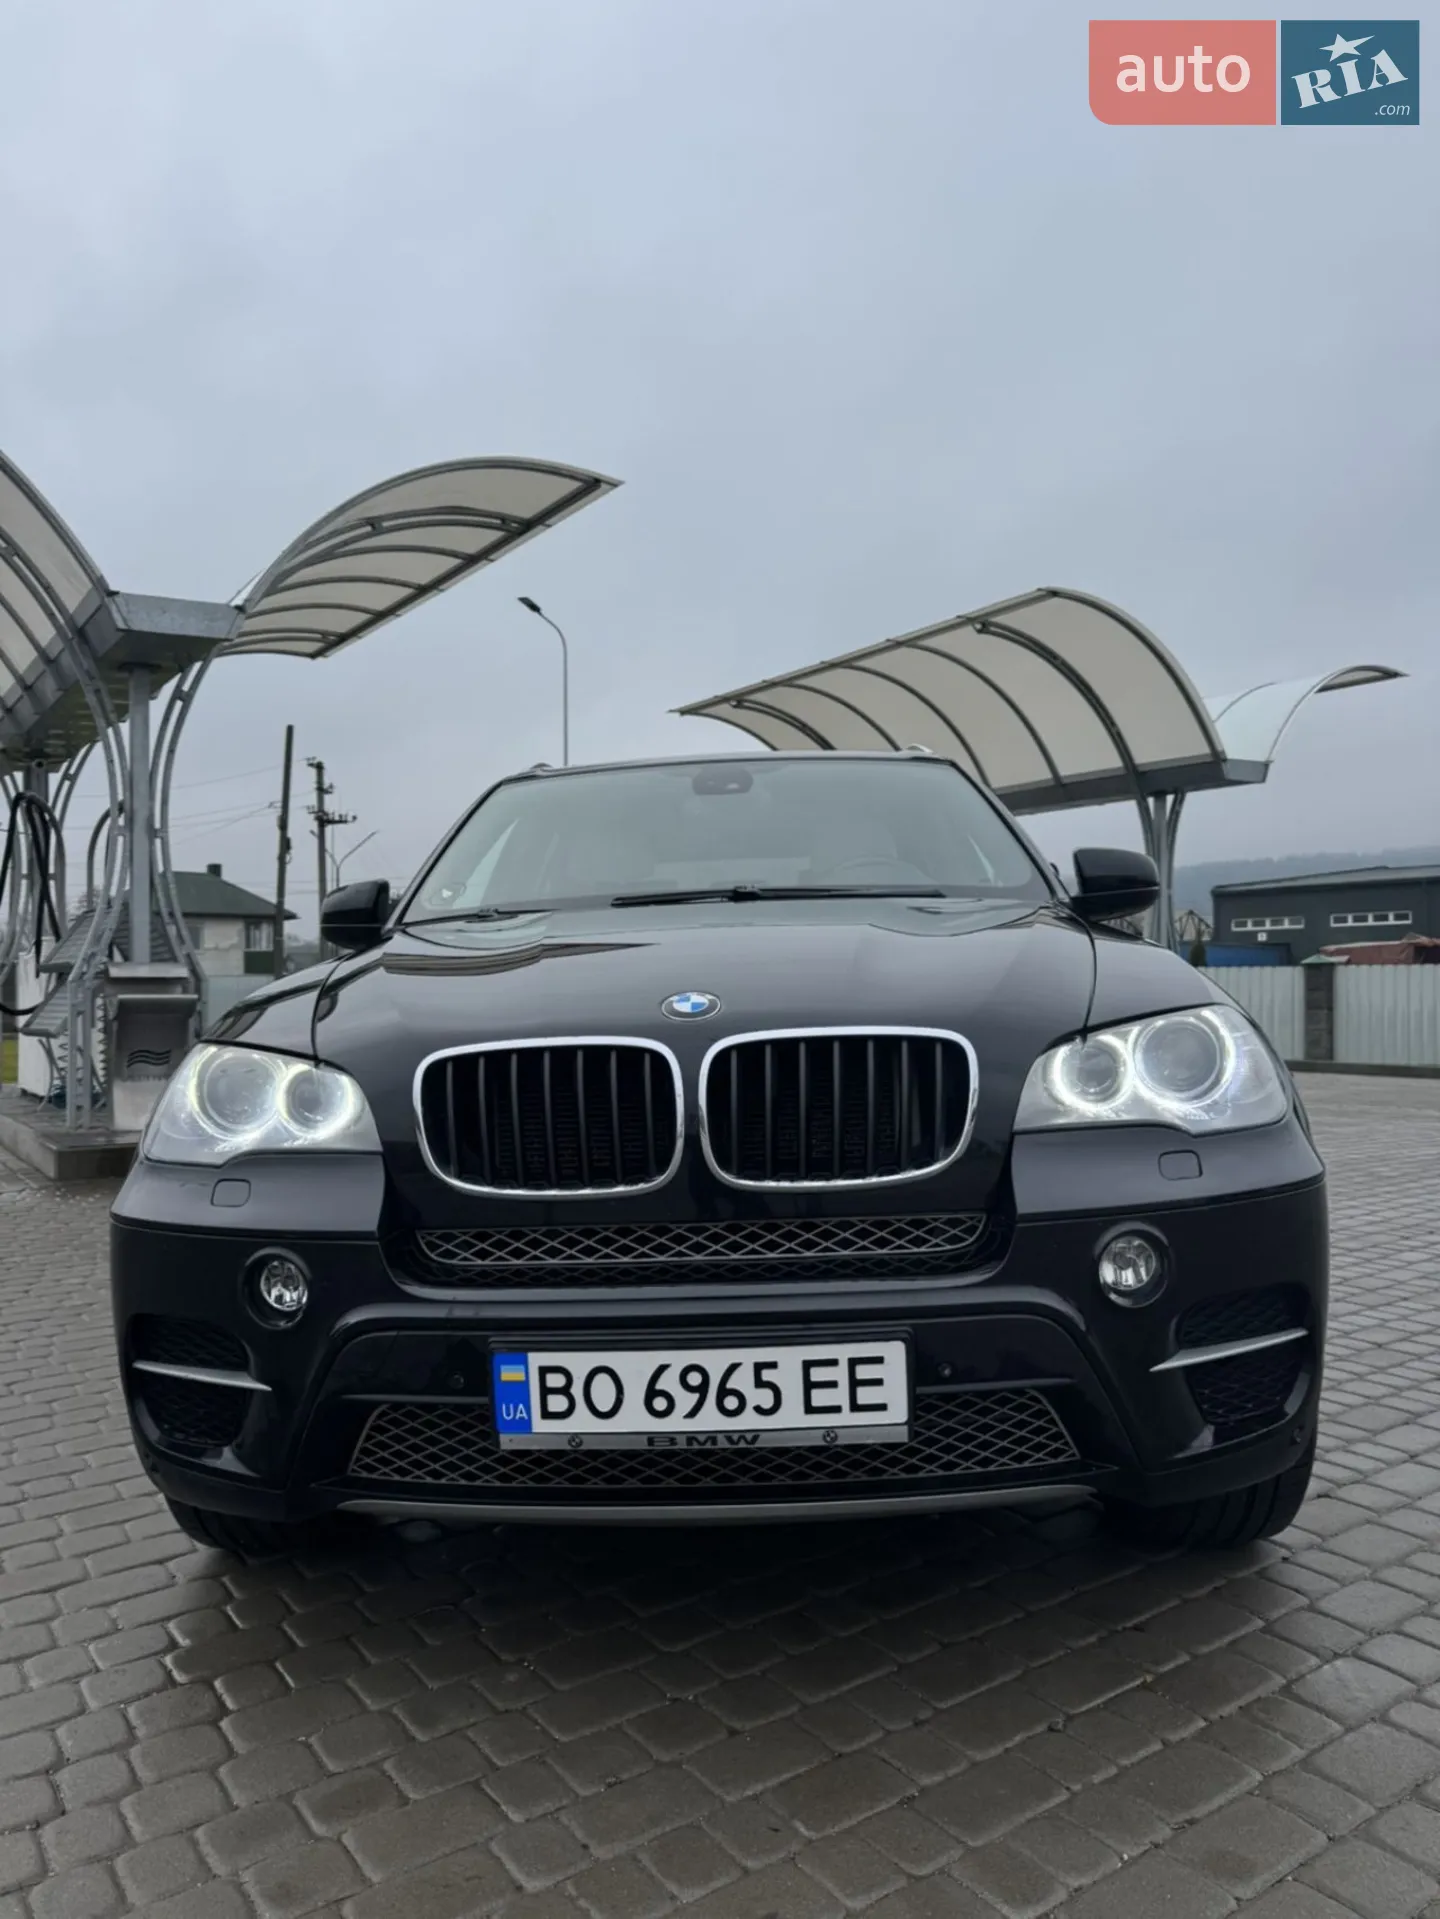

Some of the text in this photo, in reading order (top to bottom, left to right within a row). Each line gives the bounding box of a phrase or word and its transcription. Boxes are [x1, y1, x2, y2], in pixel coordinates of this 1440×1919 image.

[537, 1355, 888, 1420] BO 6965 EE
[502, 1403, 528, 1420] UA
[647, 1434, 760, 1447] BMW
